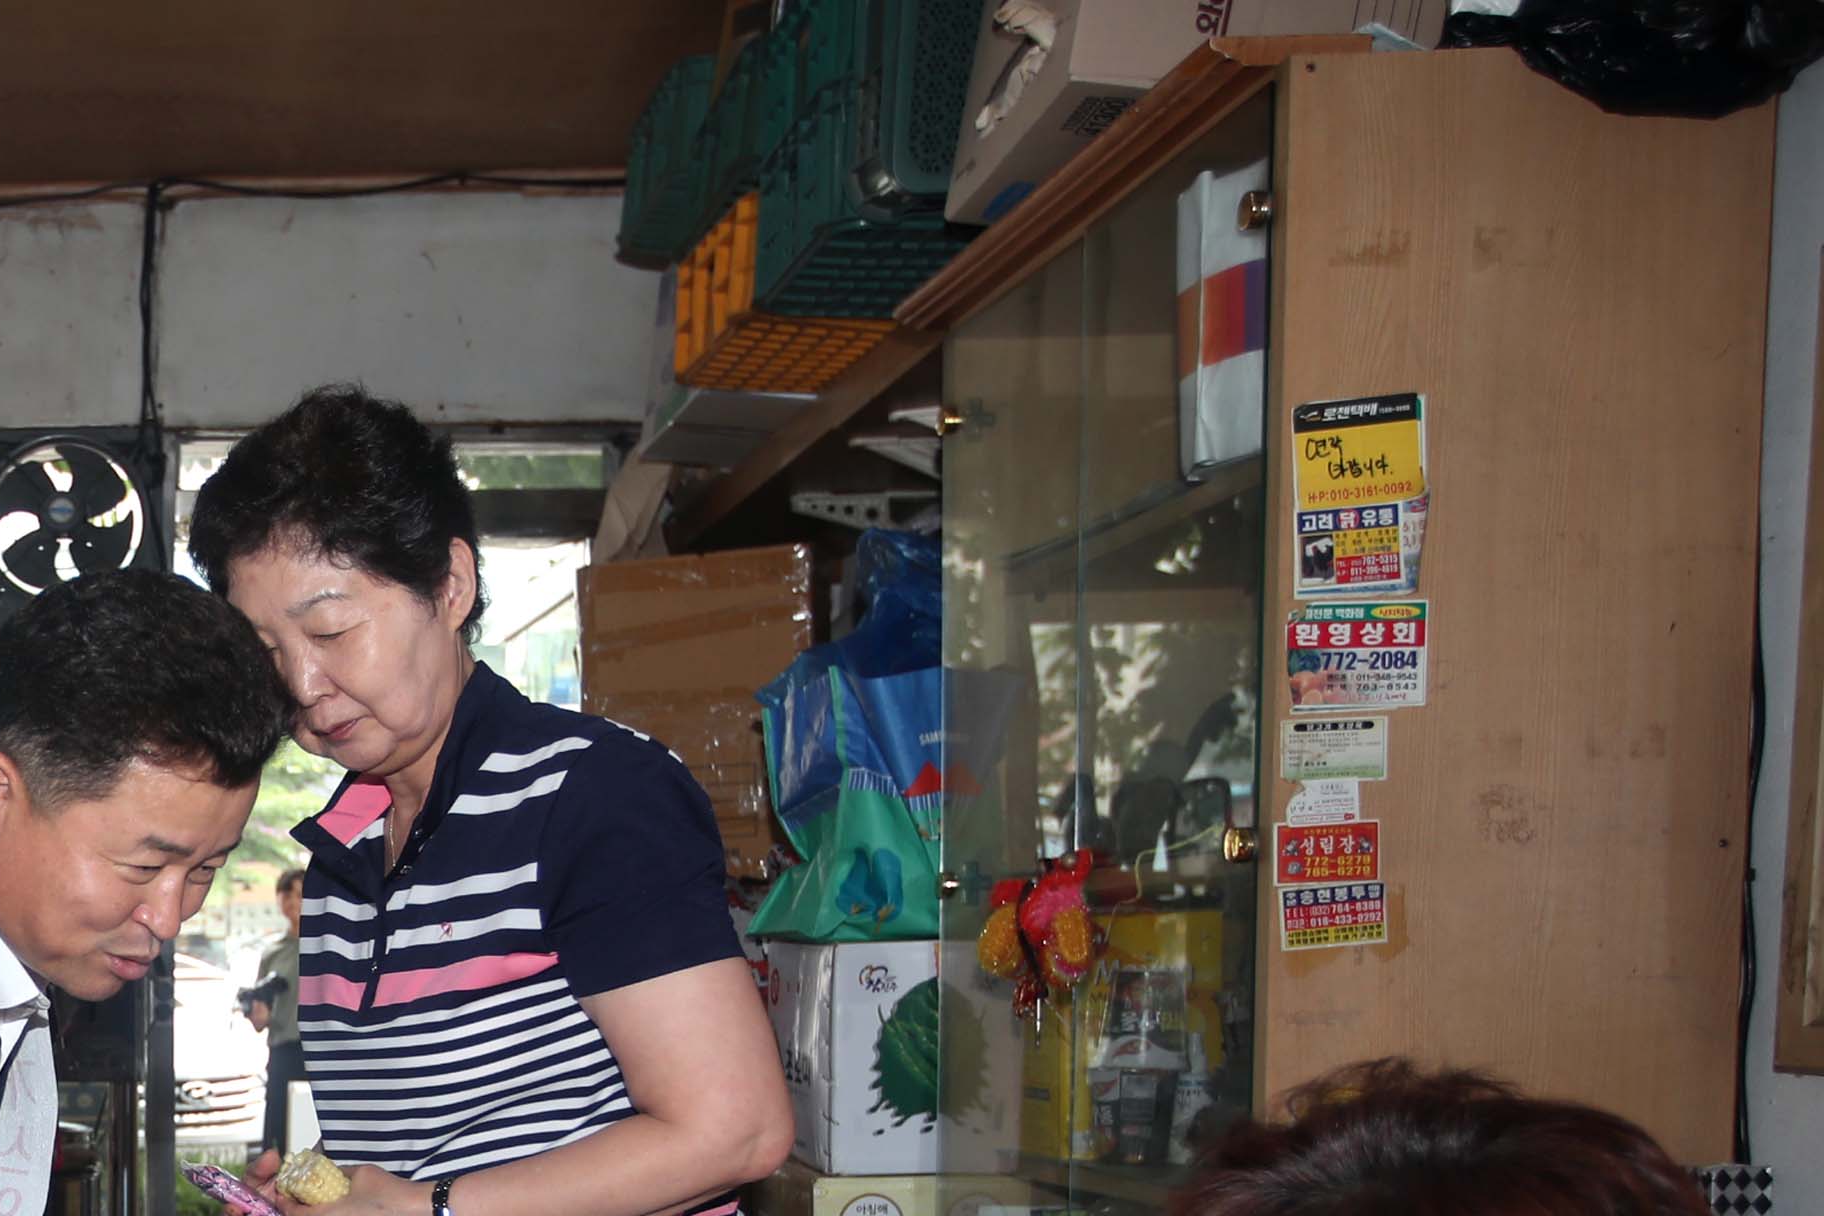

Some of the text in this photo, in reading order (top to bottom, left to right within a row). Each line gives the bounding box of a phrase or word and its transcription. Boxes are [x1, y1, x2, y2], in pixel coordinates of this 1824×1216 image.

[1321, 403, 1378, 422] 로젠택배
[1302, 508, 1393, 532] 고려 닭 유통
[1321, 650, 1418, 671] 772-2084
